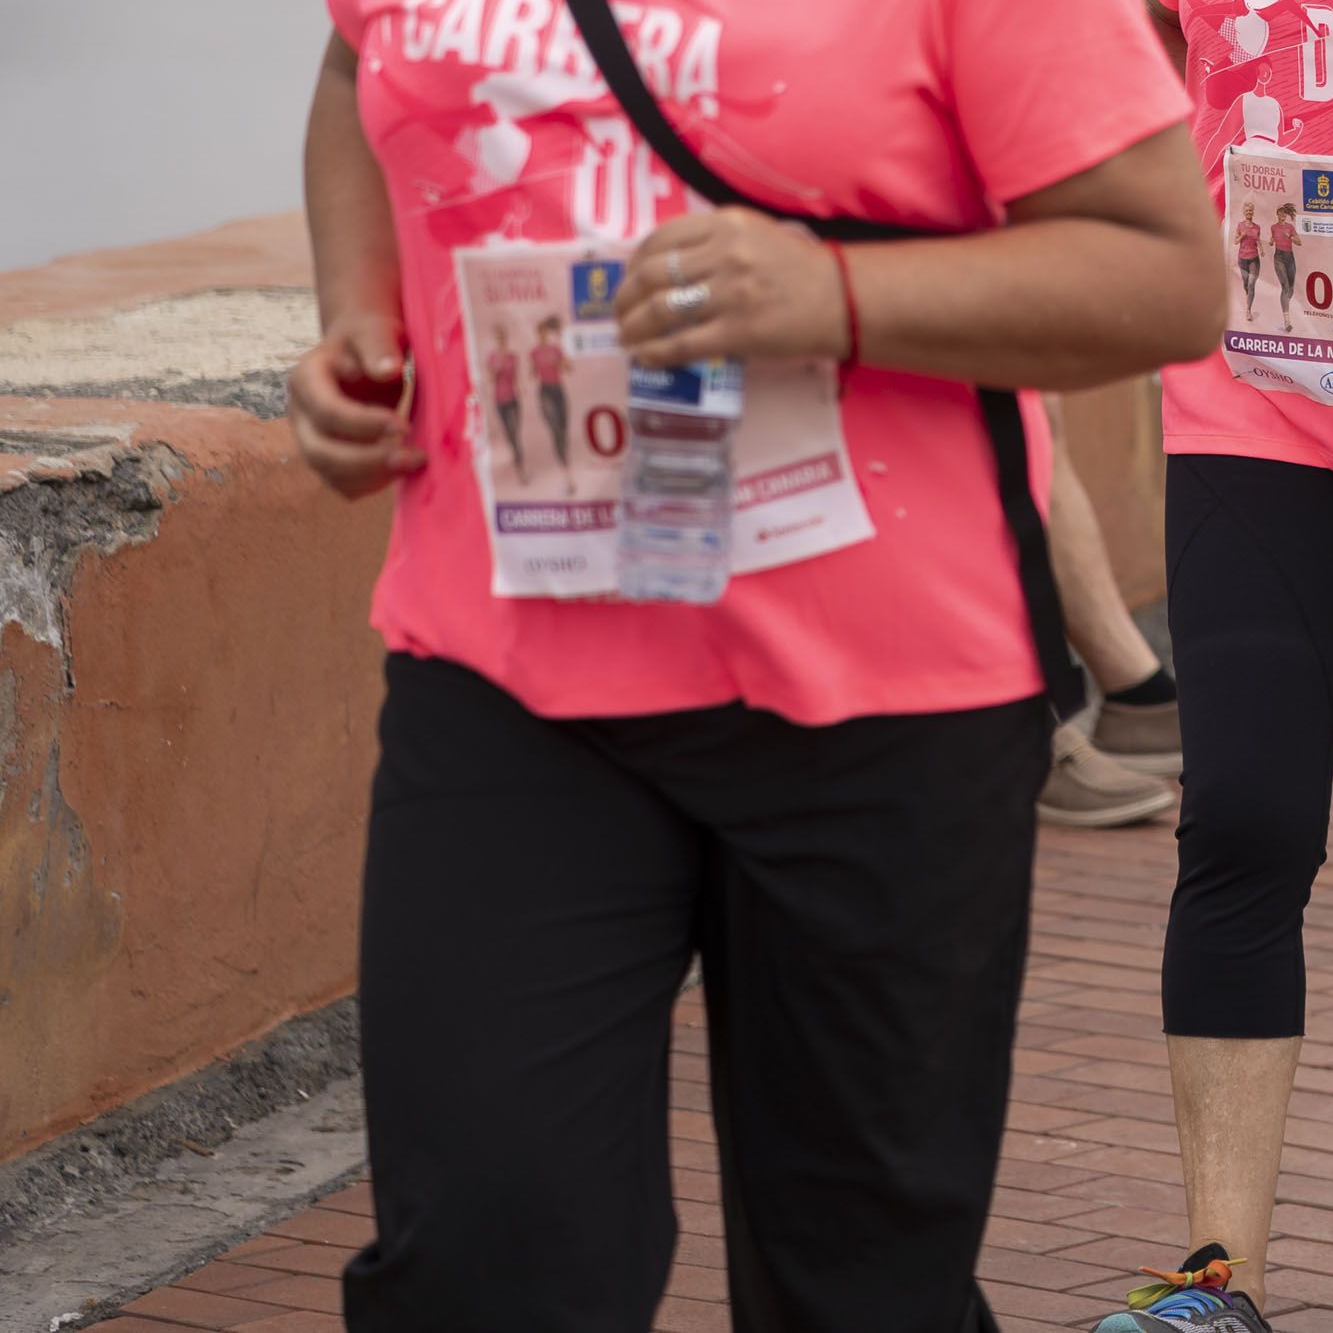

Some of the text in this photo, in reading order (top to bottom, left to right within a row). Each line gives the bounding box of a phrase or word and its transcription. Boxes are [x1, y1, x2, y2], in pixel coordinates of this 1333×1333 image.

[1252, 165, 1287, 178] DORSAL
[1243, 174, 1287, 193] SUMA
[1230, 336, 1285, 355] CARRERA
[1288, 342, 1304, 356] DE
[1307, 344, 1323, 358] LA
[1253, 367, 1294, 385] OYSHO
